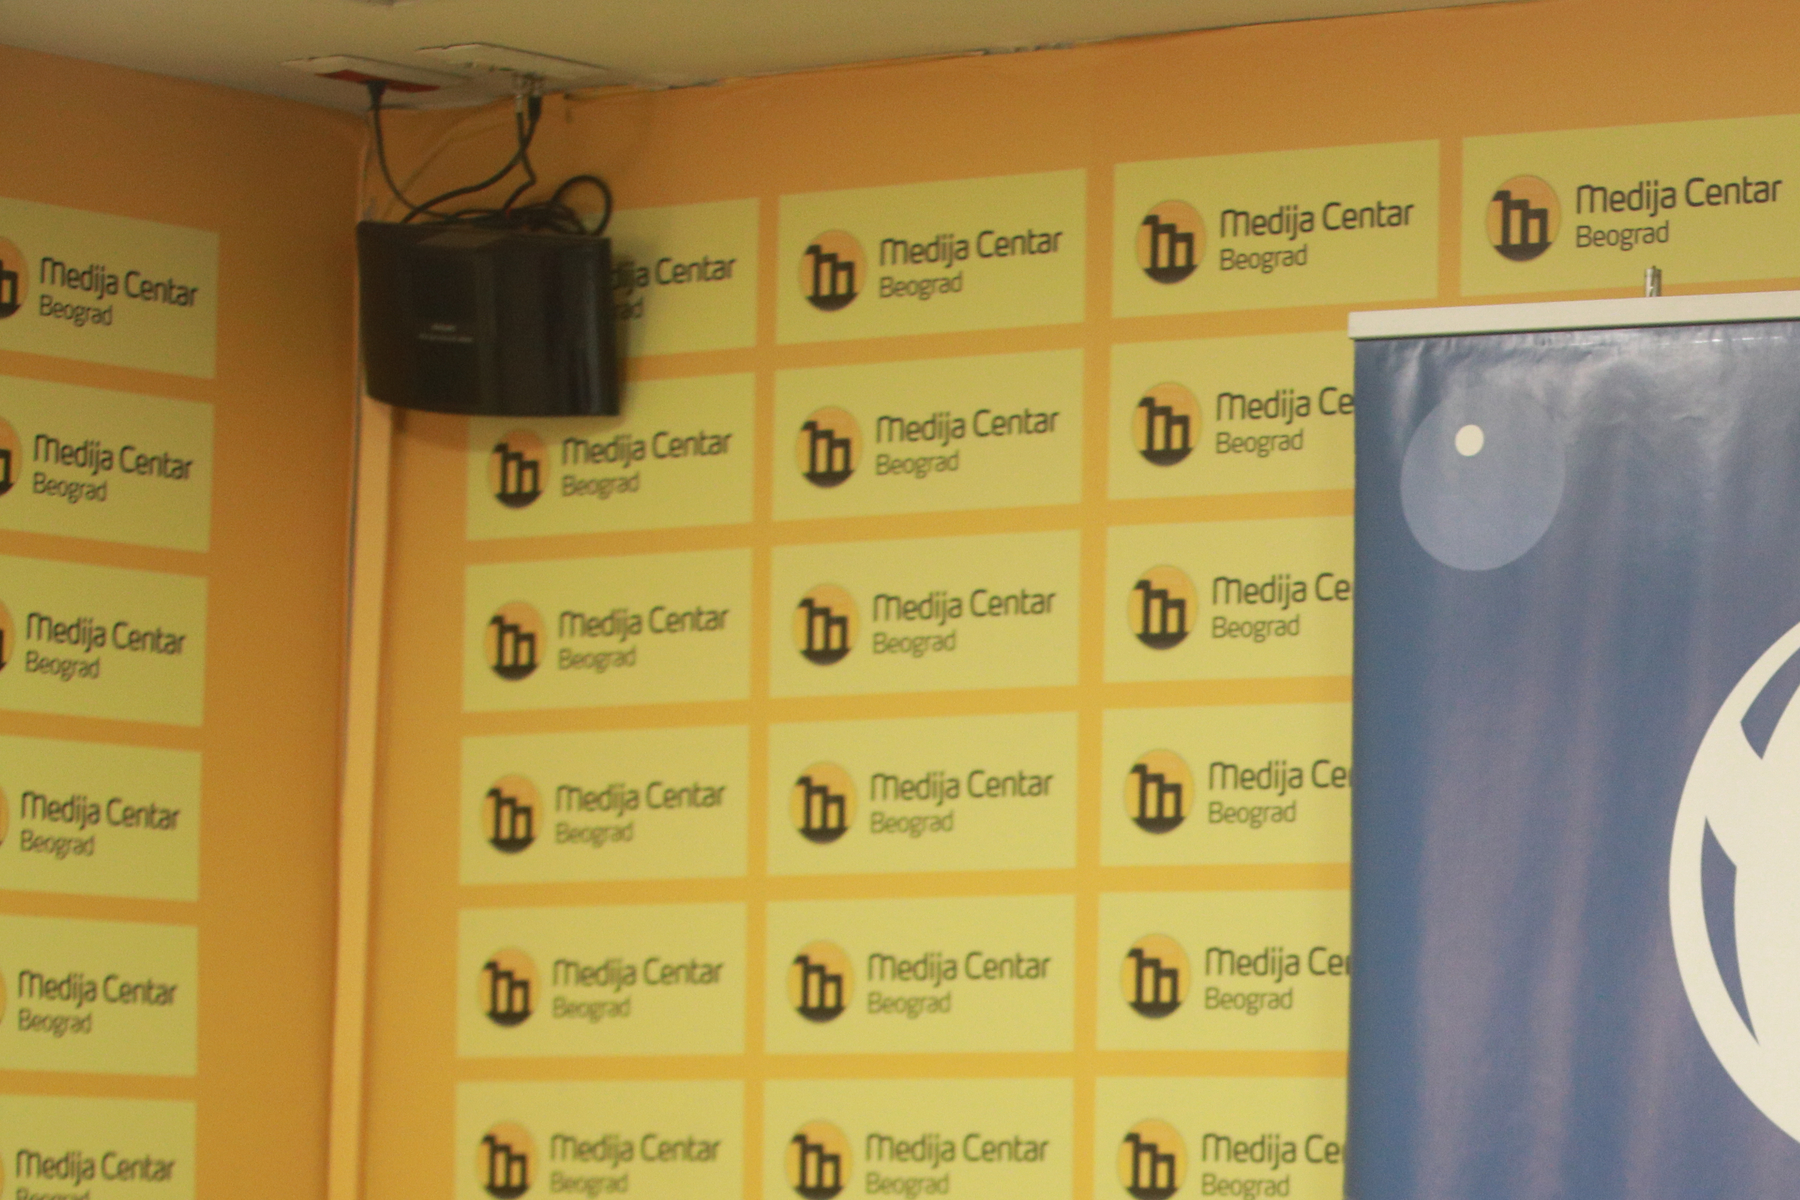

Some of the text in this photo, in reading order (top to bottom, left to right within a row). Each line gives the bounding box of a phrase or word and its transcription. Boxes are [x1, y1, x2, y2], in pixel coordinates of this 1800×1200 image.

[1575, 175, 1783, 219] Medija Centar
[1321, 200, 1415, 232] Centar
[975, 229, 1064, 260] Centar
[1575, 220, 1670, 252] Beograd
[654, 256, 737, 286] Centar
[1219, 244, 1308, 275] Beograd
[123, 269, 199, 308] Centar
[879, 272, 963, 301] Beograd
[39, 293, 113, 328] Beograd
[972, 408, 1060, 438] Centar
[651, 430, 733, 460] Centar
[1215, 430, 1304, 459] Beograd
[118, 444, 194, 481] Centar
[876, 452, 959, 479] Beograd
[32, 471, 108, 505] Beograd
[562, 473, 640, 500] Beograd
[969, 588, 1056, 618] Centar
[648, 605, 729, 635] Centar
[1212, 615, 1300, 643] Beograd
[111, 620, 187, 656] Centar
[873, 630, 957, 658] Beograd
[25, 649, 101, 682] Beograd
[558, 647, 637, 675] Beograd
[645, 780, 726, 810] Centar
[967, 769, 1054, 799] Centar
[105, 796, 181, 831] Centar
[870, 810, 954, 837] Beograd
[1208, 801, 1296, 829] Beograd
[20, 828, 95, 860] Beograd
[556, 823, 634, 849] Beograd
[643, 956, 723, 986] Centar
[964, 950, 1051, 981] Centar
[102, 973, 178, 1007] Centar
[867, 991, 952, 1019] Beograd
[1205, 987, 1294, 1015] Beograd
[18, 1008, 92, 1038] Beograd
[553, 997, 631, 1023] Beograd
[640, 1133, 720, 1162] Centar
[962, 1132, 1049, 1163] Centar
[100, 1151, 175, 1182] Centar
[550, 1173, 629, 1199] Beograd
[865, 1173, 950, 1200] Beograd
